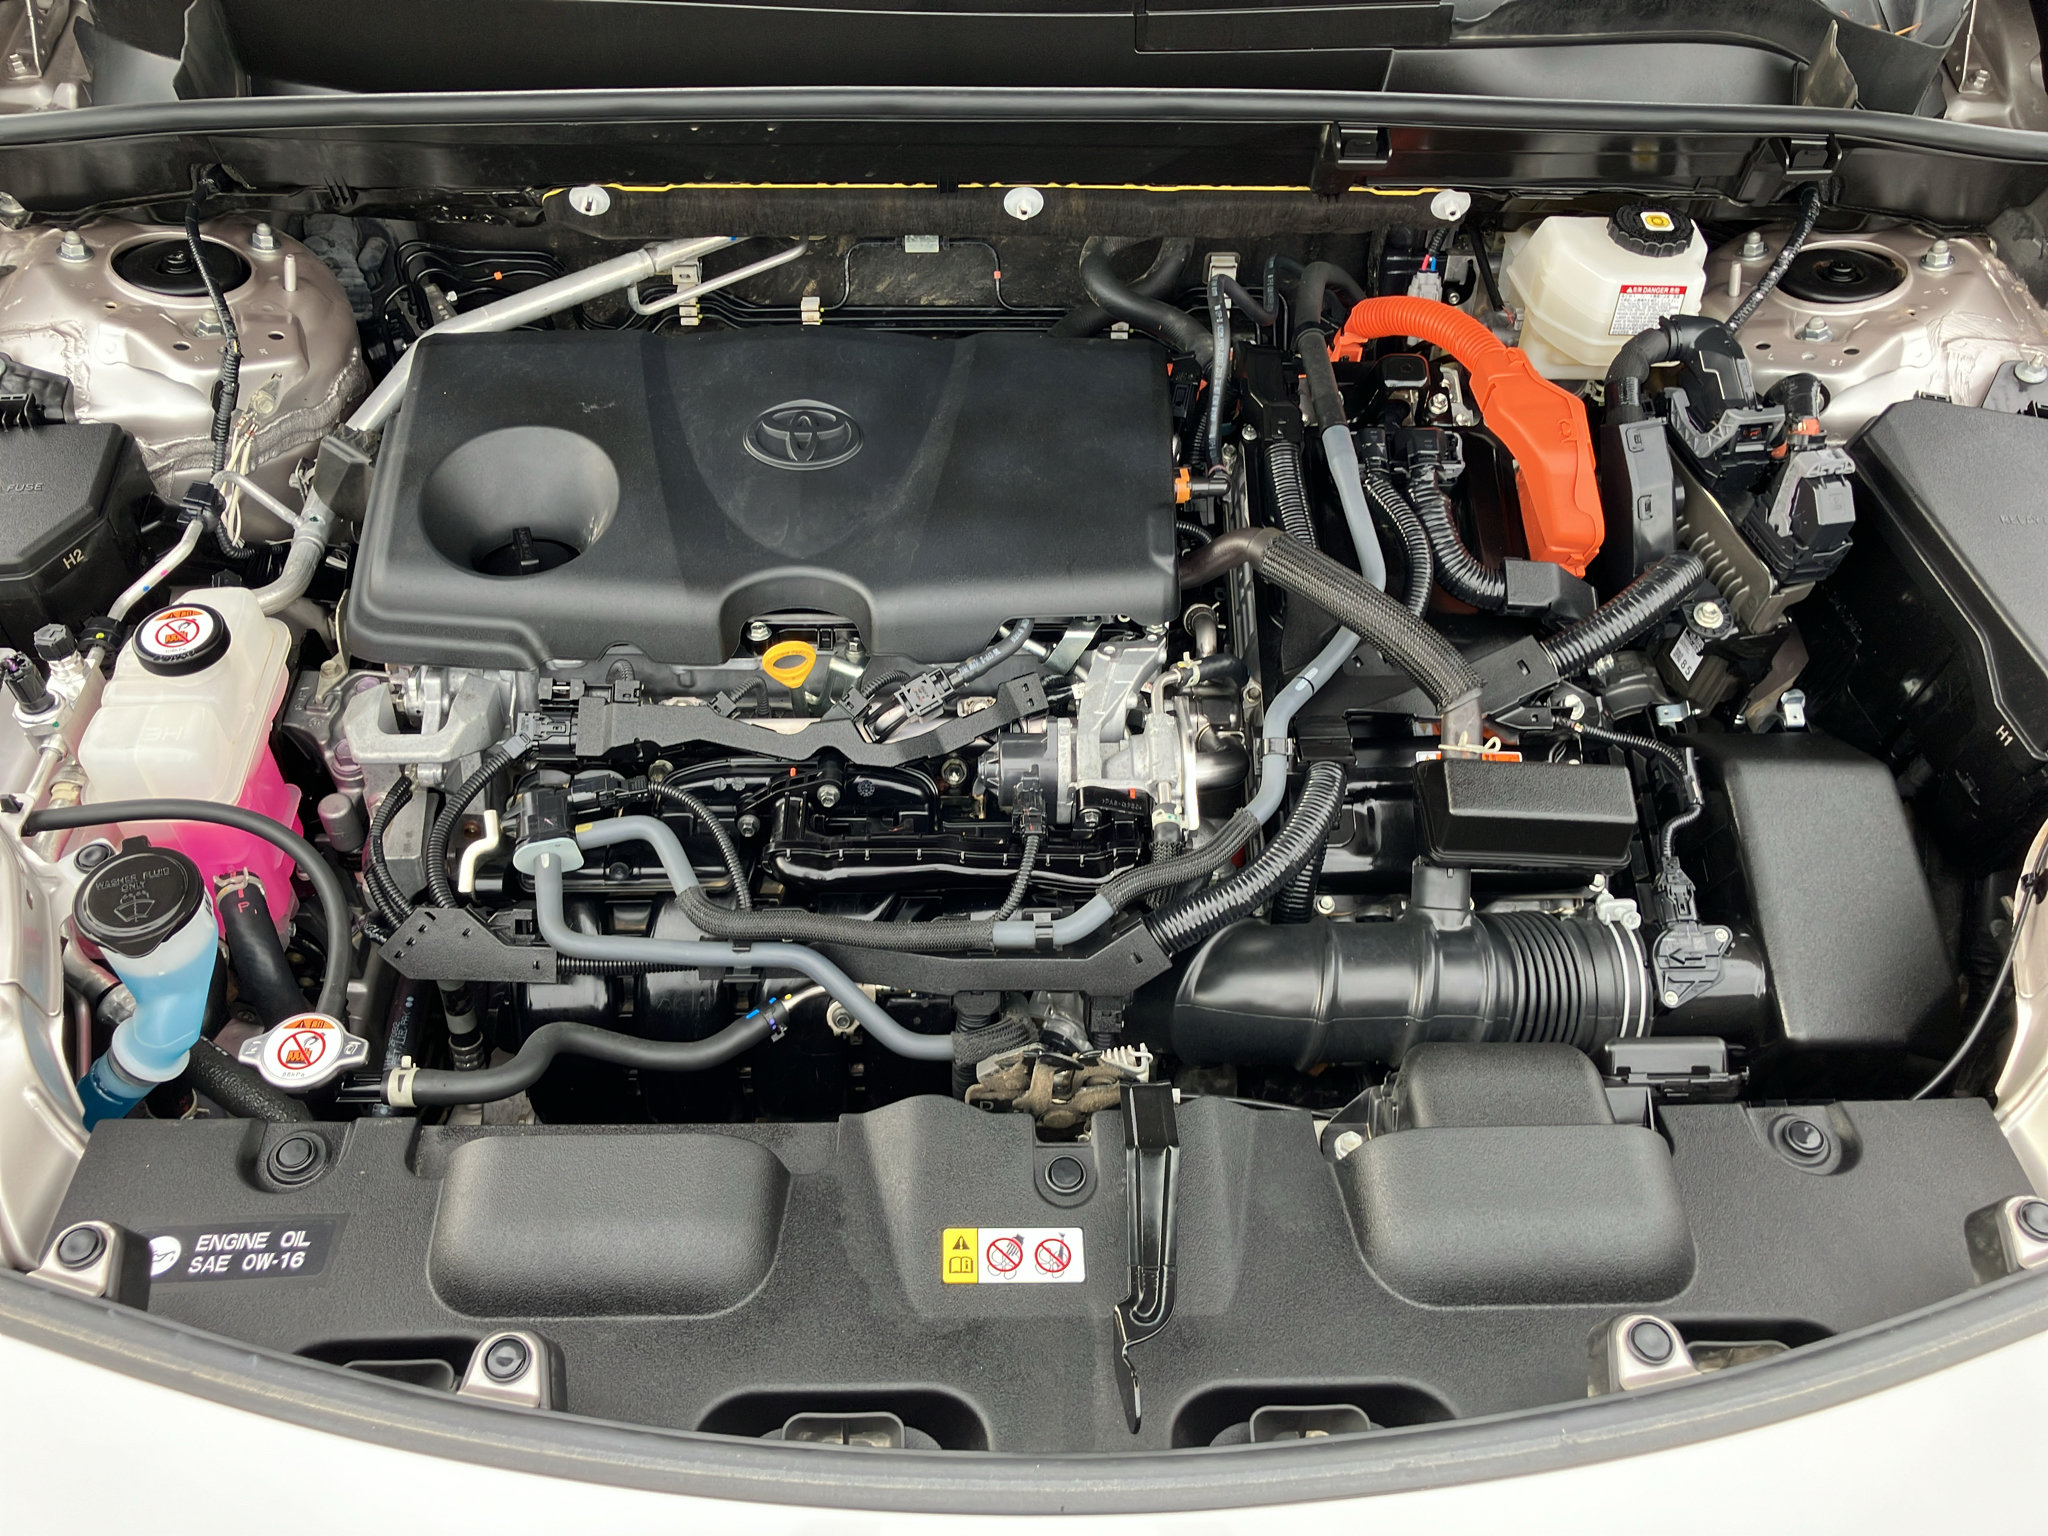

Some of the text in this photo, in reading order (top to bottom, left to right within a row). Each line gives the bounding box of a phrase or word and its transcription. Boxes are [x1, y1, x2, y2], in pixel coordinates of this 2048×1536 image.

[6, 482, 44, 493] FUSE
[62, 548, 85, 570] H2
[1995, 724, 2014, 747] H1
[95, 867, 170, 891] WASHER FLUID
[121, 880, 146, 892] ONLY
[194, 1230, 312, 1252] ENGINE OIL
[187, 1254, 233, 1274] SAE
